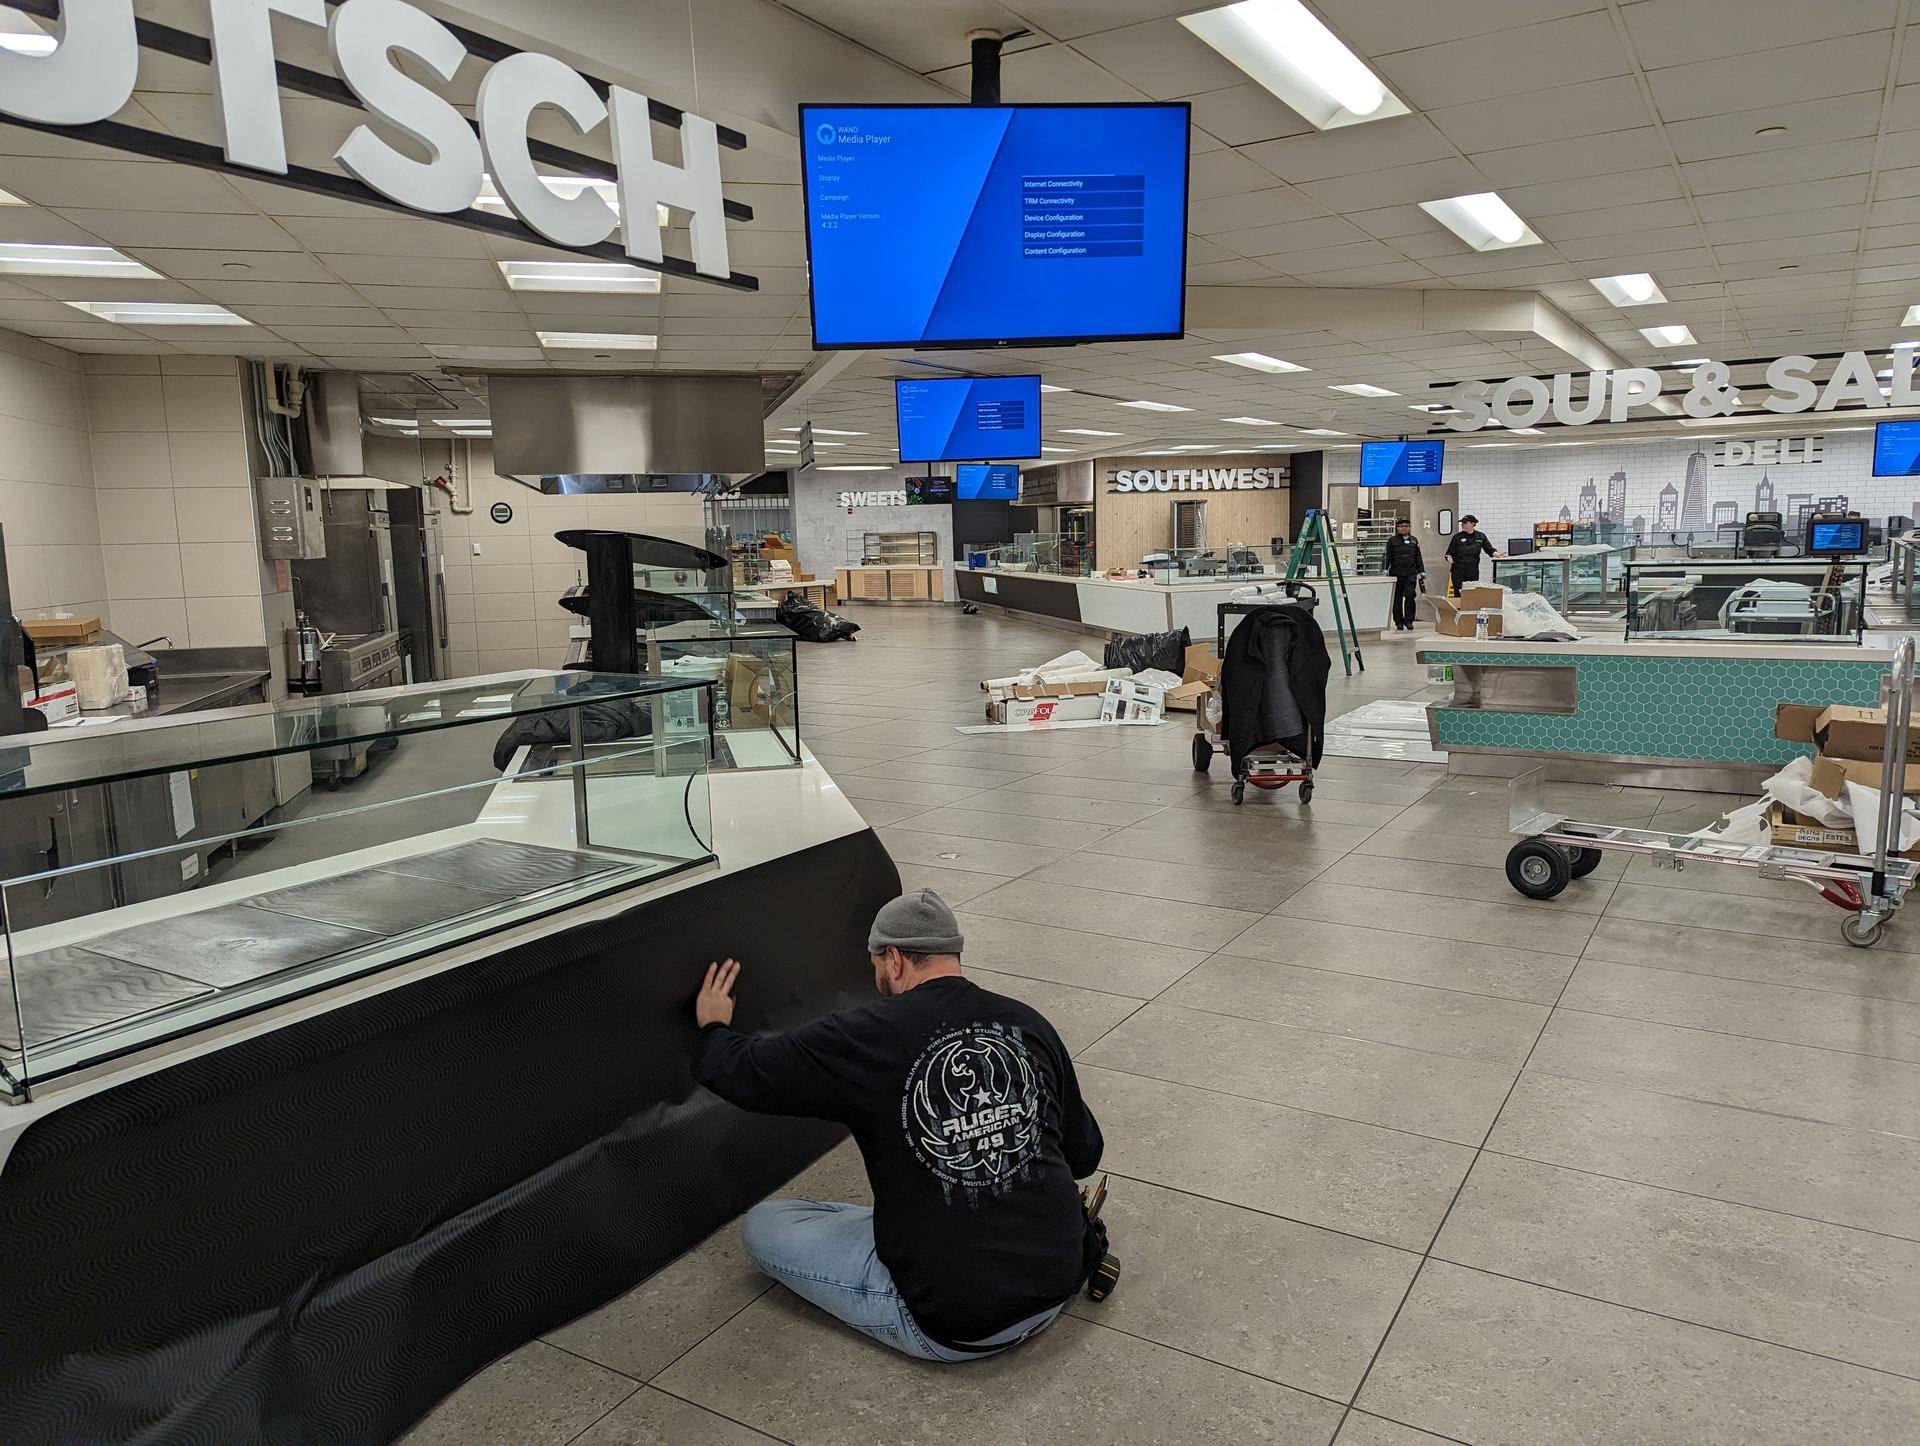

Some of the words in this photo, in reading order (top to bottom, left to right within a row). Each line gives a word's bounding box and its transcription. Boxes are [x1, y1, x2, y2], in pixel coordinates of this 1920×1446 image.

[837, 126, 859, 134] WAND
[838, 134, 864, 144] Media
[865, 134, 891, 146] Player
[836, 155, 855, 163] Player
[818, 174, 840, 183] Display
[1024, 180, 1047, 188] Internet
[1047, 180, 1083, 189] Connectivity
[819, 194, 850, 202] Campaign
[1024, 197, 1039, 205] TRM
[1039, 197, 1076, 206] Connectivity
[821, 213, 839, 221] Media
[839, 213, 858, 221] Player
[858, 212, 880, 220] Version
[1024, 214, 1045, 222] Device
[1044, 214, 1084, 223] Configuration
[821, 221, 839, 230] 4.3.2
[1024, 231, 1046, 240] Display
[1046, 230, 1085, 239] Configuration
[1024, 247, 1048, 255] Content
[1048, 246, 1087, 255] Configuration
[1444, 367, 1663, 433] SOUP
[1682, 360, 1742, 419] &
[1724, 437, 1815, 467] DELI
[1116, 467, 1286, 492] SOUTHWEST
[840, 490, 908, 508] SWEETS
[1825, 833, 1850, 843] ESTES
[942, 1102, 1026, 1137] RUGER
[952, 1115, 1021, 1144] AMERICAN
[976, 1132, 1005, 1151] 49
